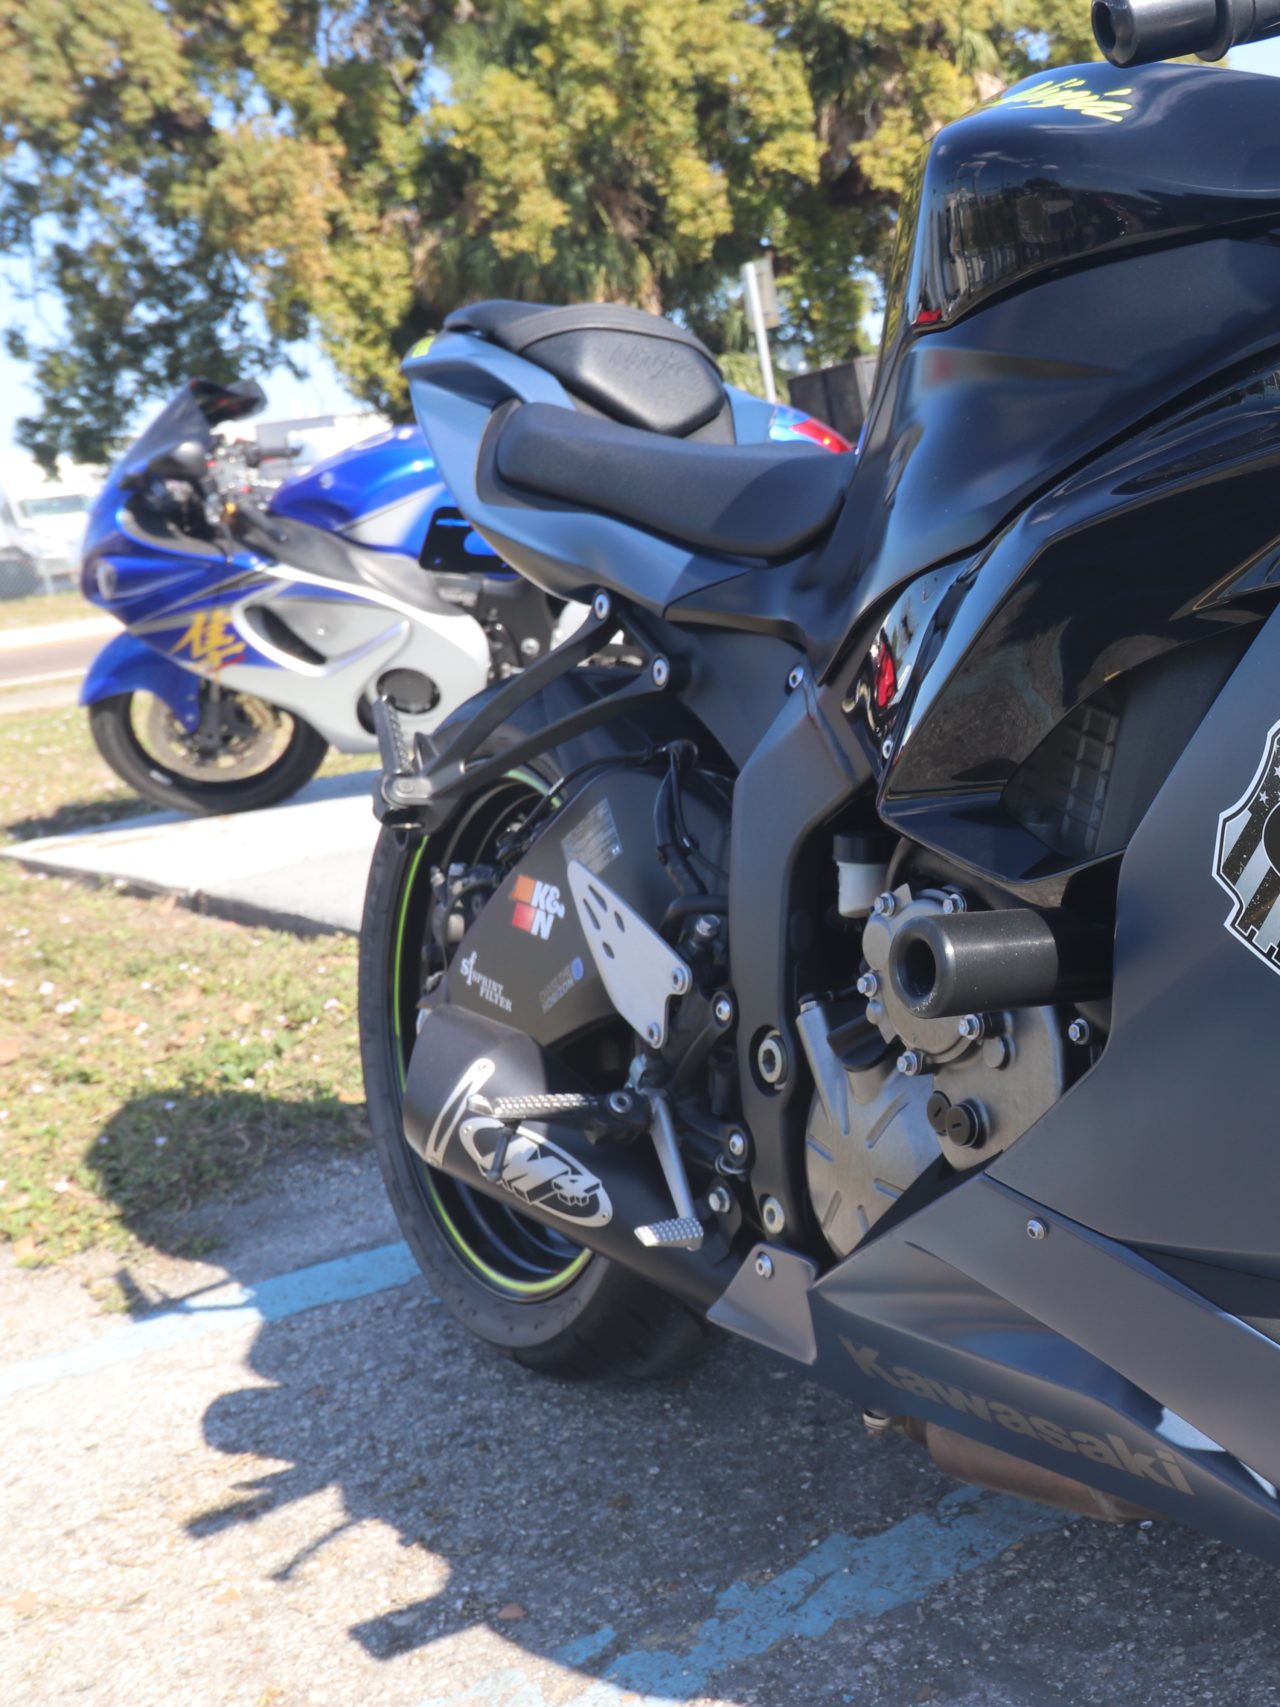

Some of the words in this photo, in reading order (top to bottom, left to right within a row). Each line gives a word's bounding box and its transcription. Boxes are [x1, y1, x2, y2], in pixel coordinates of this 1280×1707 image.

[472, 972, 505, 994] SPRINT
[479, 985, 513, 1013] FILTER
[838, 1333, 1196, 1496] Kawasaki
